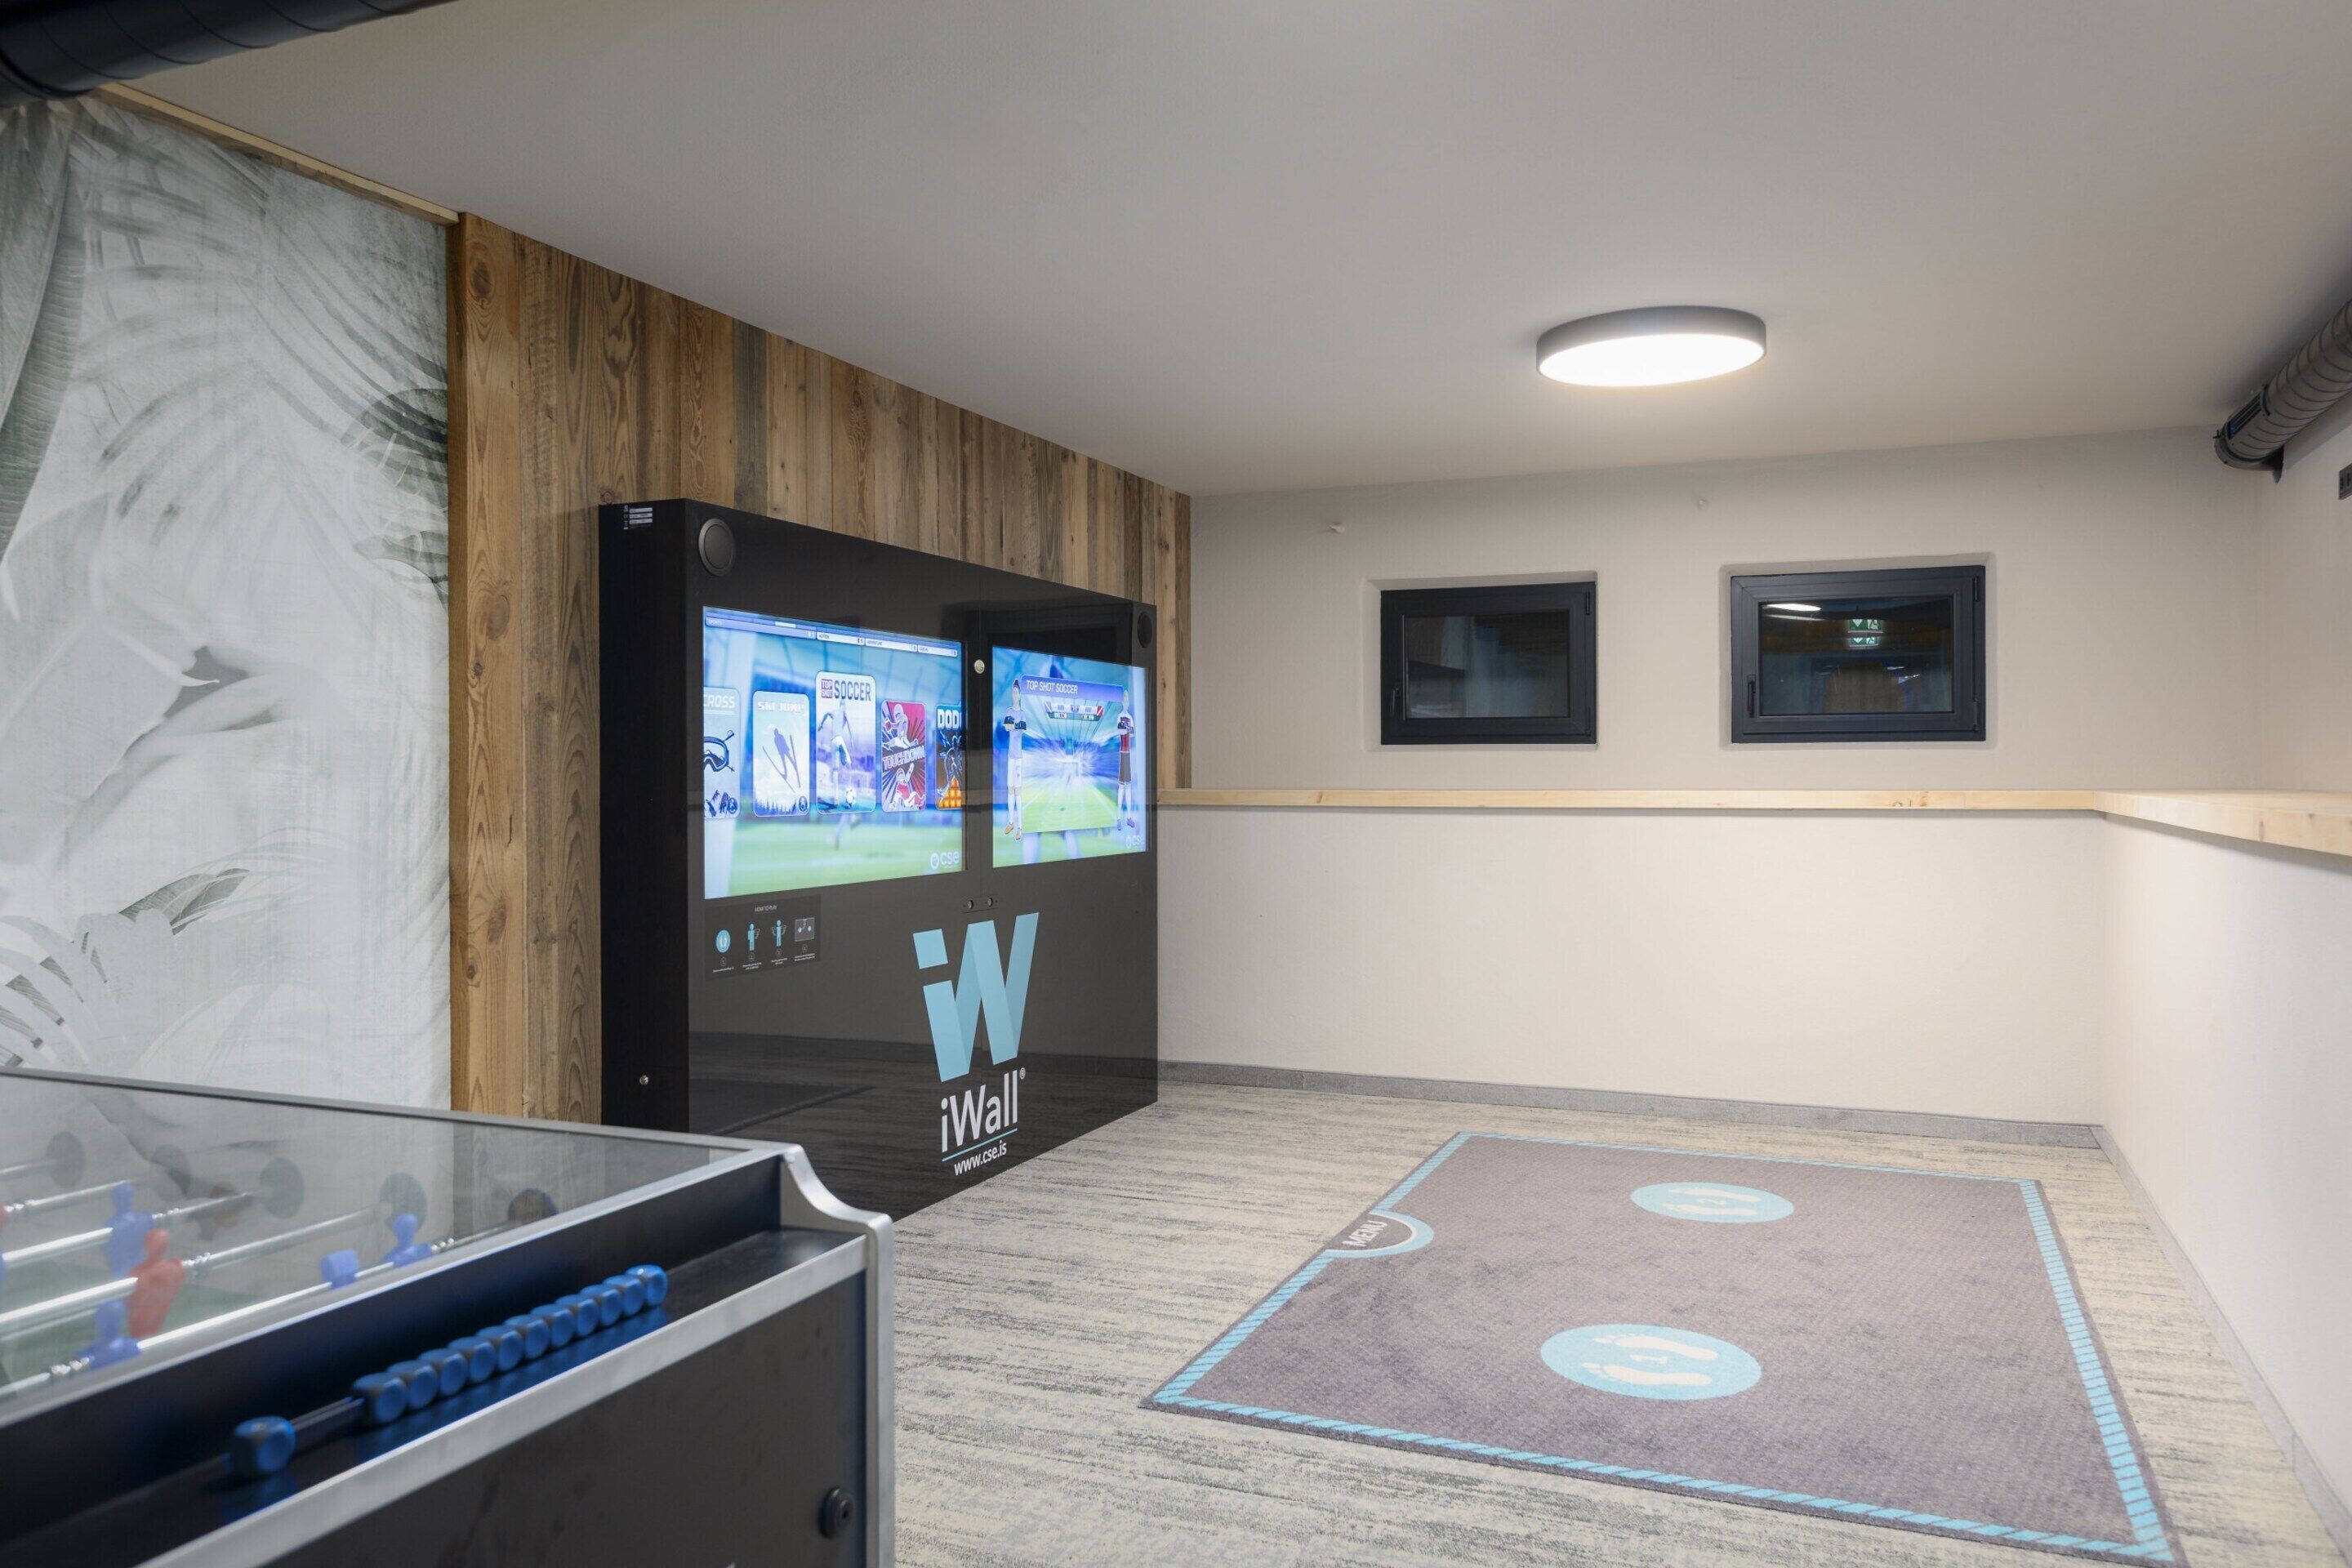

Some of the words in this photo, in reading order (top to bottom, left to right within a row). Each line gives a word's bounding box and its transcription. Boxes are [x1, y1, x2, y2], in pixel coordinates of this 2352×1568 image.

[822, 680, 832, 689] TOP
[834, 679, 871, 702] SOCCER
[1027, 679, 1038, 691] TOP
[1039, 681, 1054, 692] SHOT
[1055, 683, 1078, 694] SOCCER
[883, 745, 925, 770] TOUCHDOWN
[954, 1139, 1007, 1177] www.cse.is
[1342, 1219, 1388, 1247] MENU
